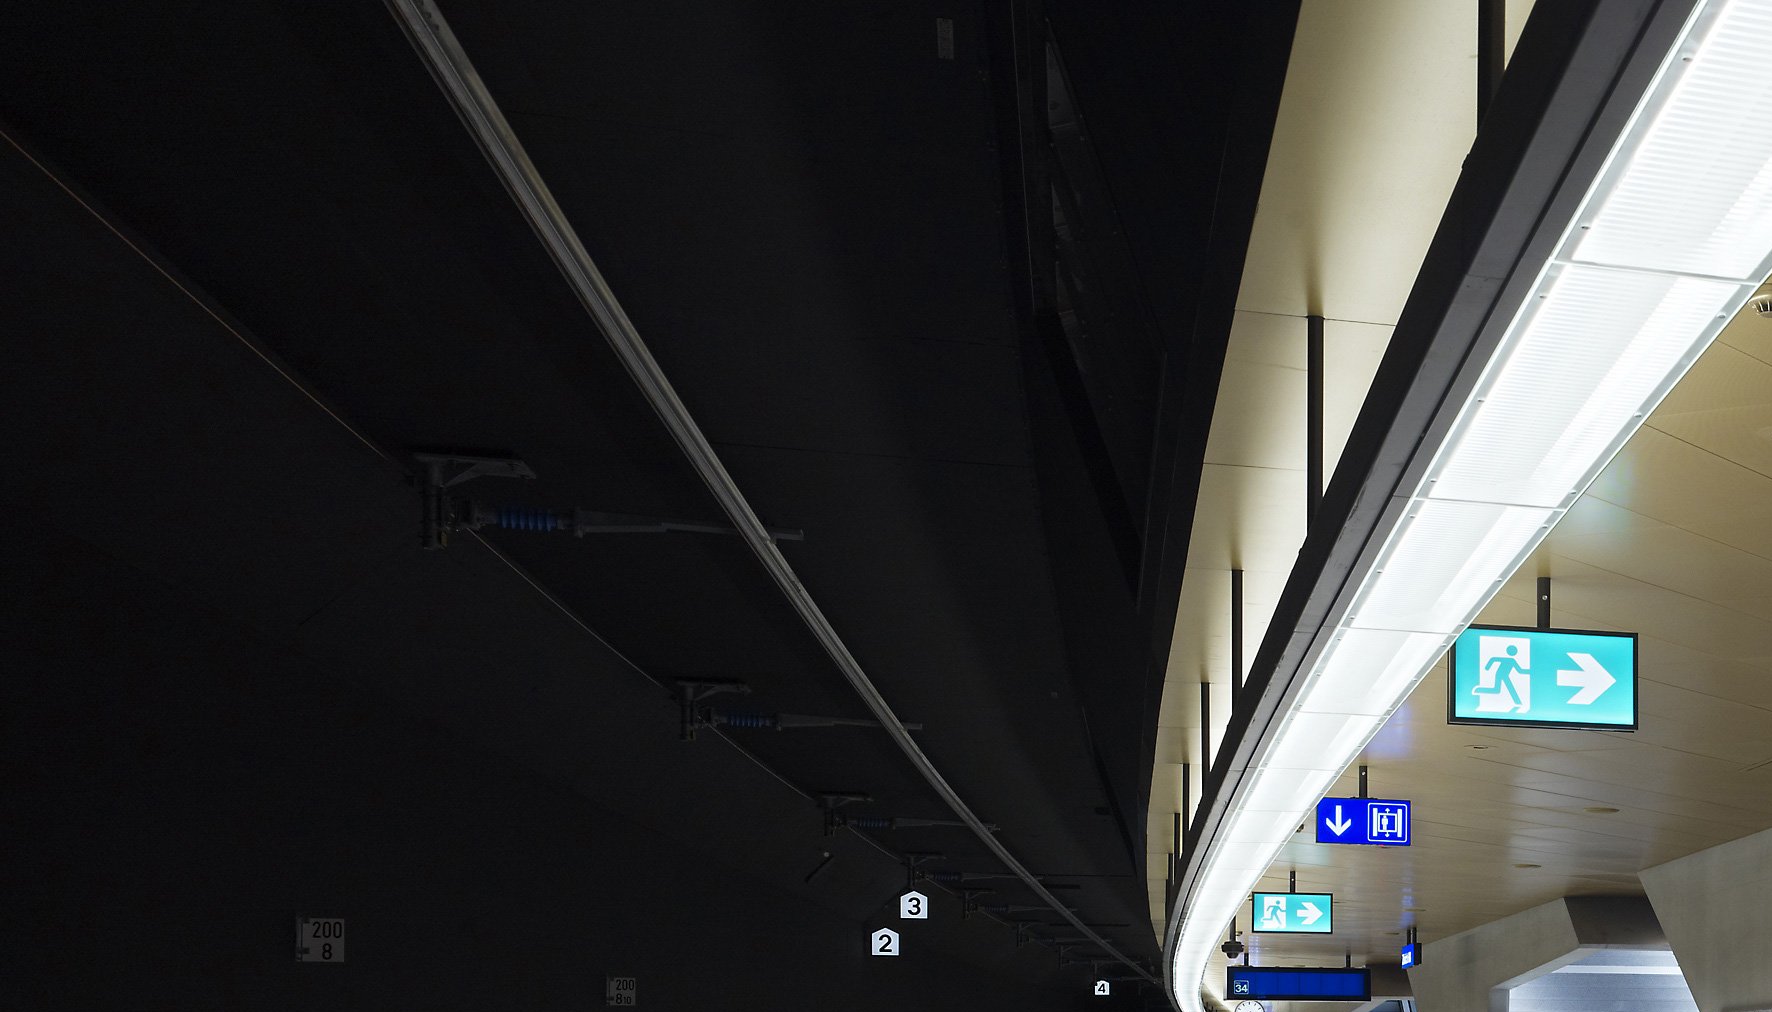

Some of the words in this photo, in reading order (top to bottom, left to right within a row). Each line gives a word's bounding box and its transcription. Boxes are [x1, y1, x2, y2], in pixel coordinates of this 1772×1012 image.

[907, 897, 921, 915] 3
[312, 921, 343, 938] 200
[322, 943, 332, 960] 8
[878, 934, 892, 952] 2
[616, 979, 634, 990] 200
[1098, 983, 1106, 993] 4
[1235, 984, 1248, 993] 34
